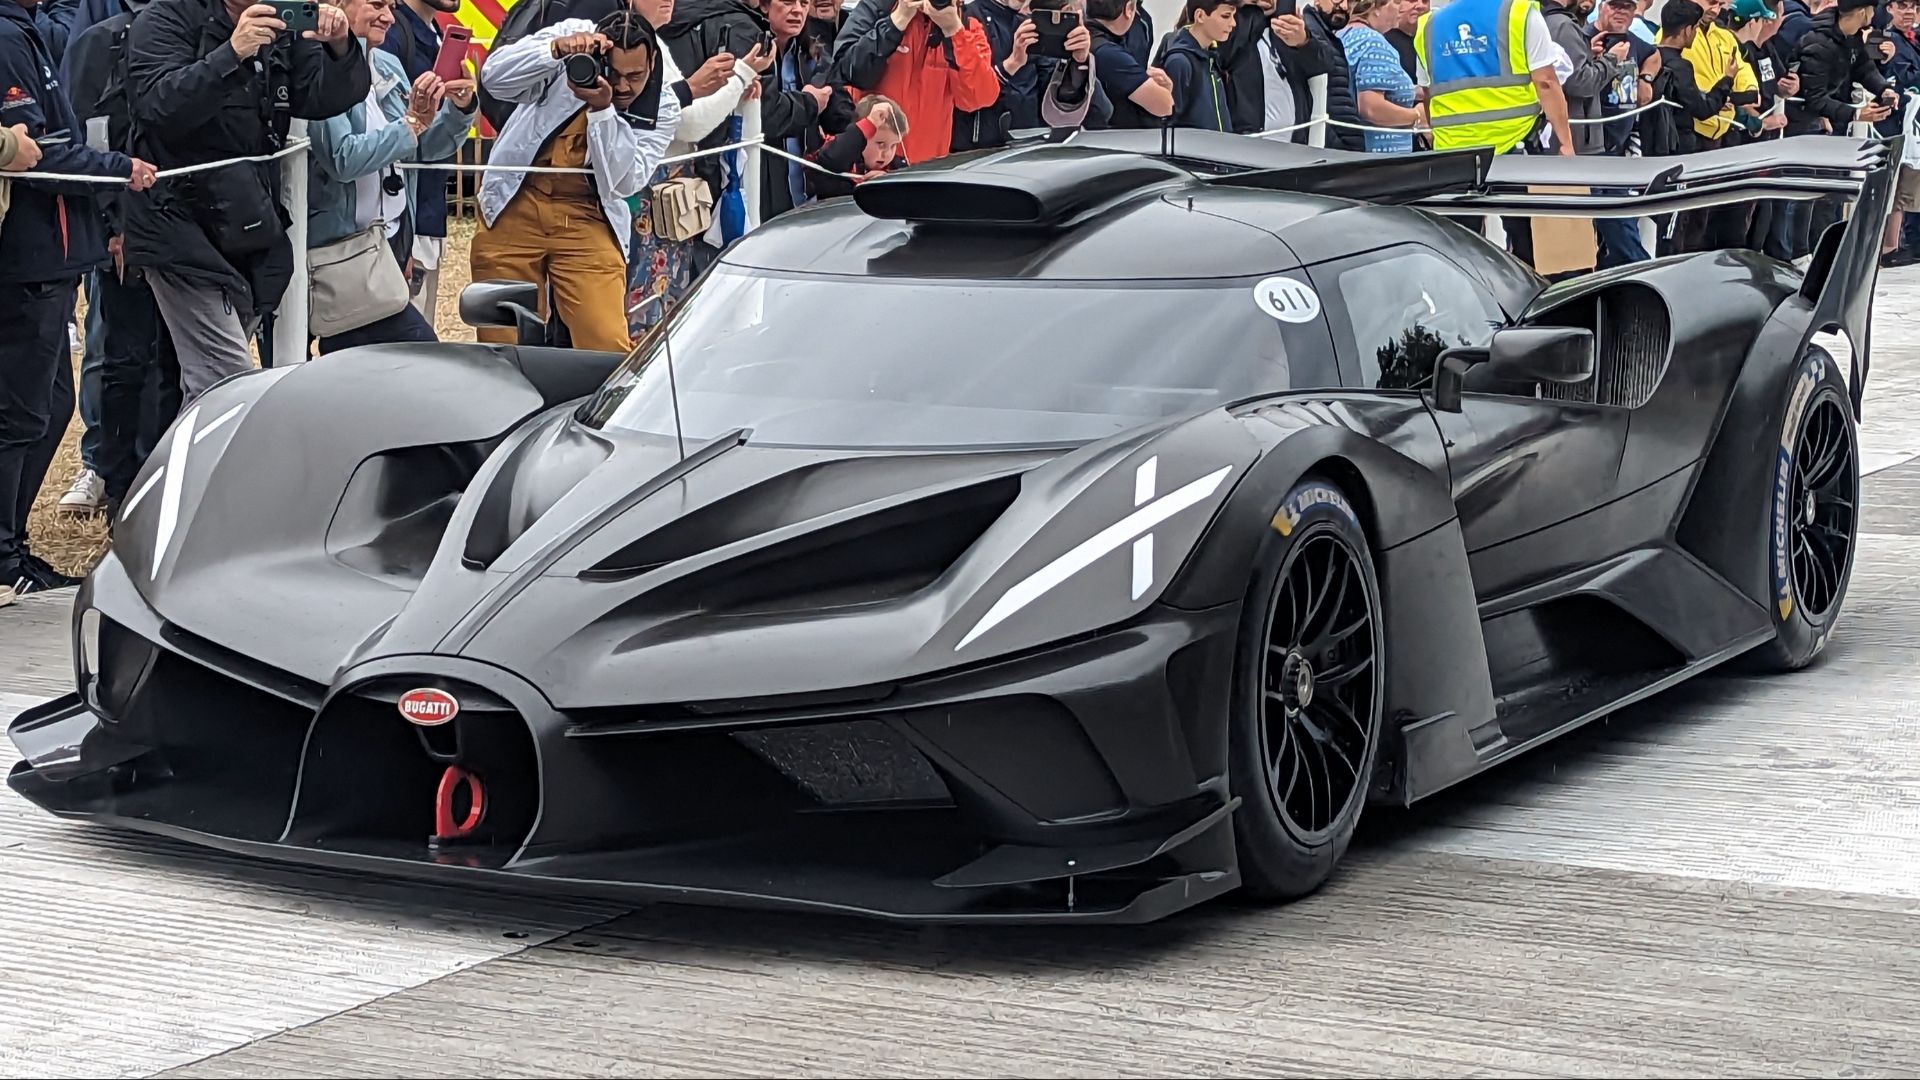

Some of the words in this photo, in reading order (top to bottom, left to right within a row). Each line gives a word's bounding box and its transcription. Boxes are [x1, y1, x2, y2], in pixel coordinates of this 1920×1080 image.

[1268, 287, 1311, 312] 611
[1776, 456, 1789, 579] MICHELIN
[404, 700, 451, 716] BUGATTI
